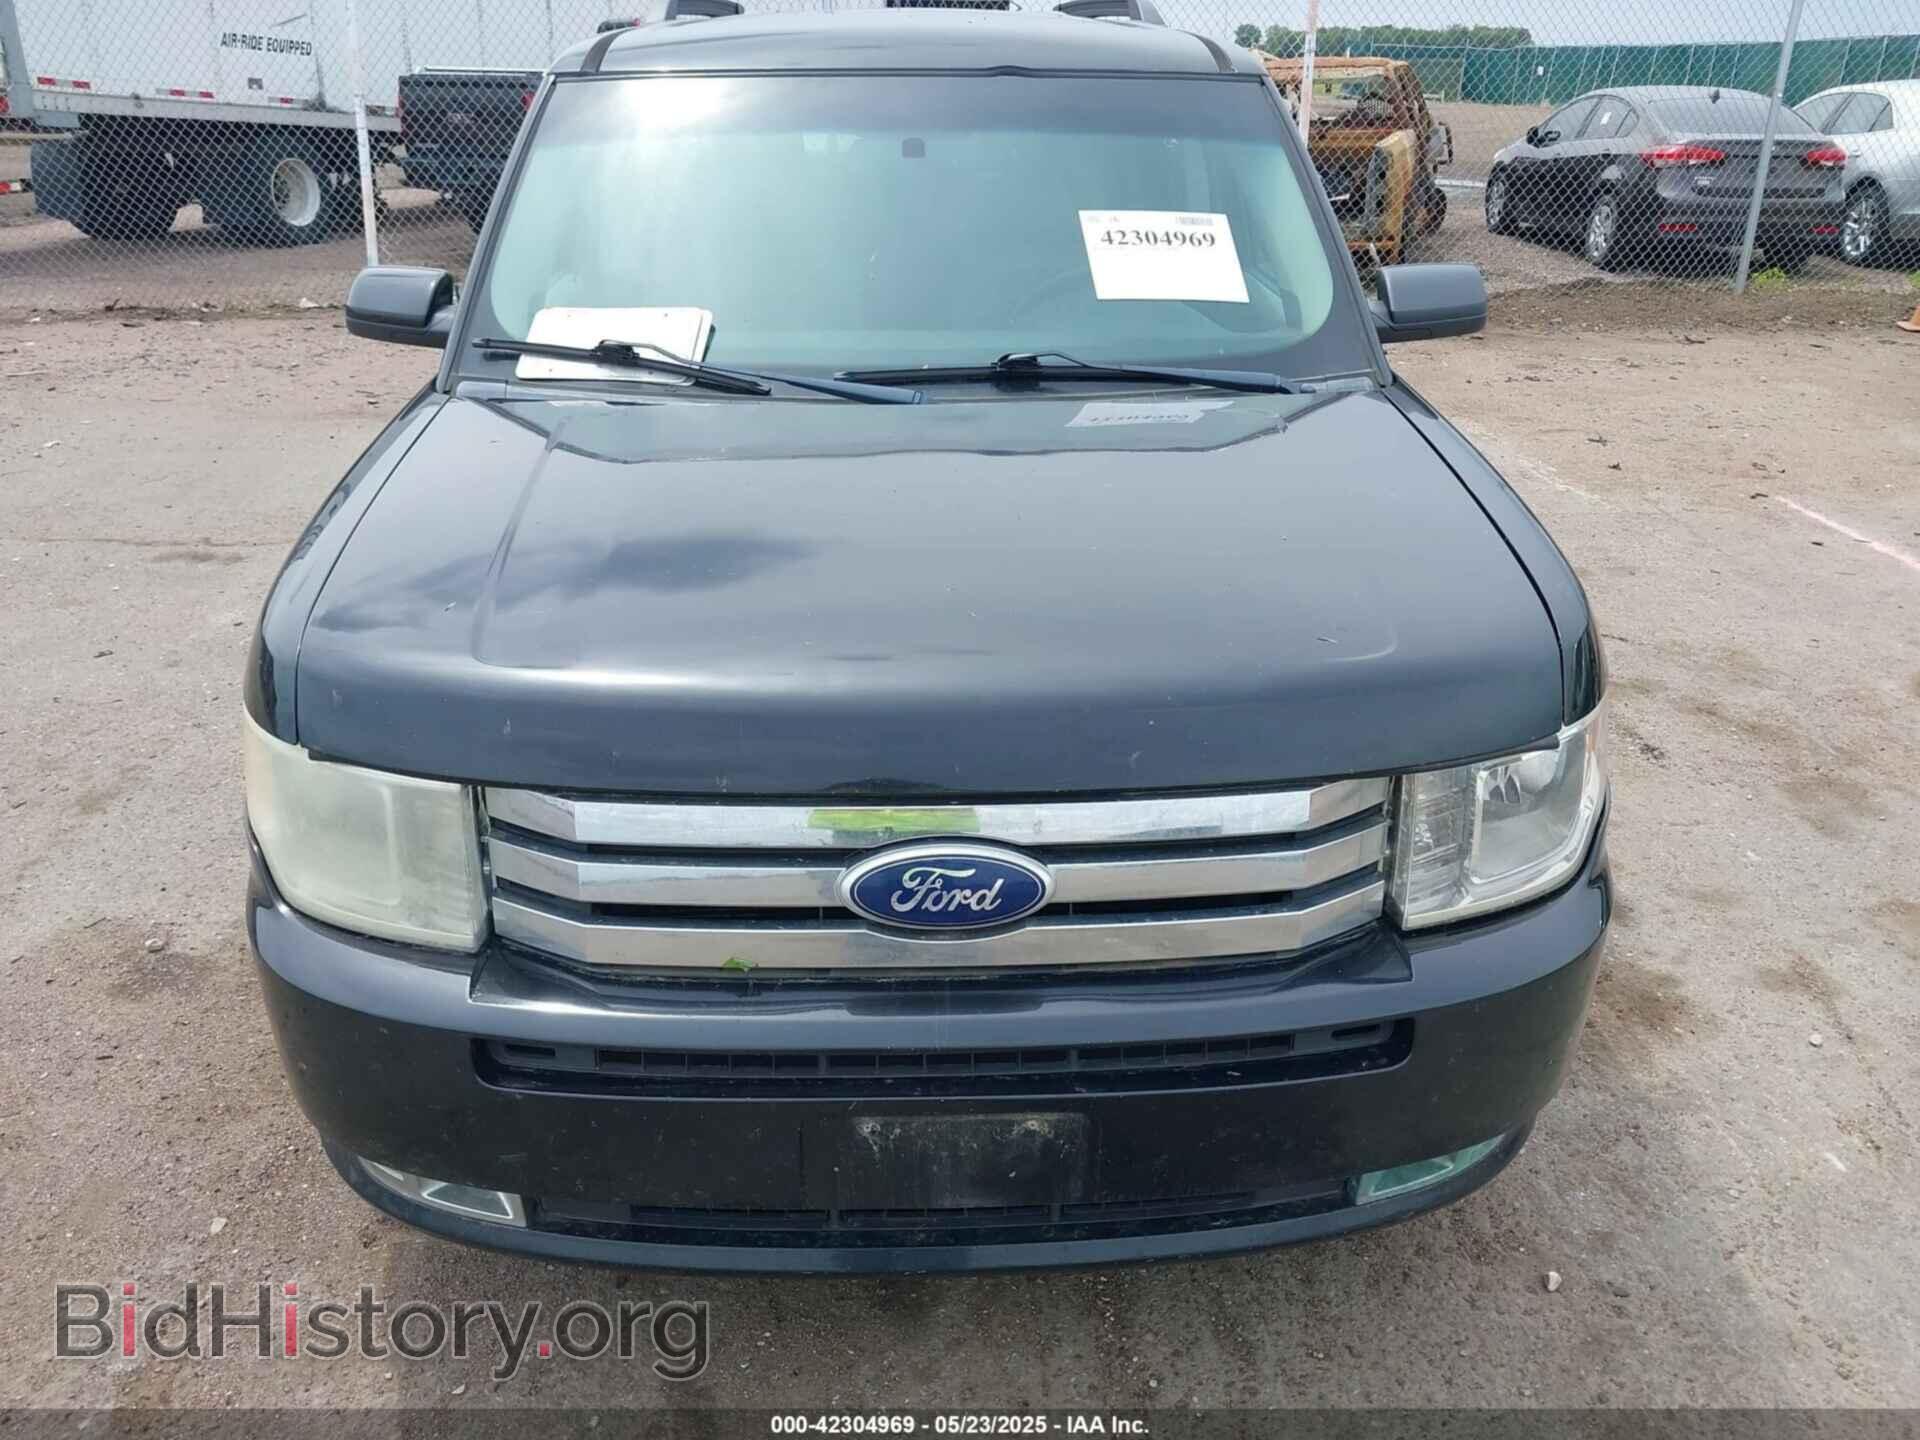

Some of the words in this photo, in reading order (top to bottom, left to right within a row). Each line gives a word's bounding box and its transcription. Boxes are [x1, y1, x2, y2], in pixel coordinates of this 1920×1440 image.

[220, 33, 264, 51] AIR-RIDE
[266, 37, 312, 56] EQUIPPED
[1100, 229, 1216, 248] 42304969
[890, 867, 1004, 912] Ford
